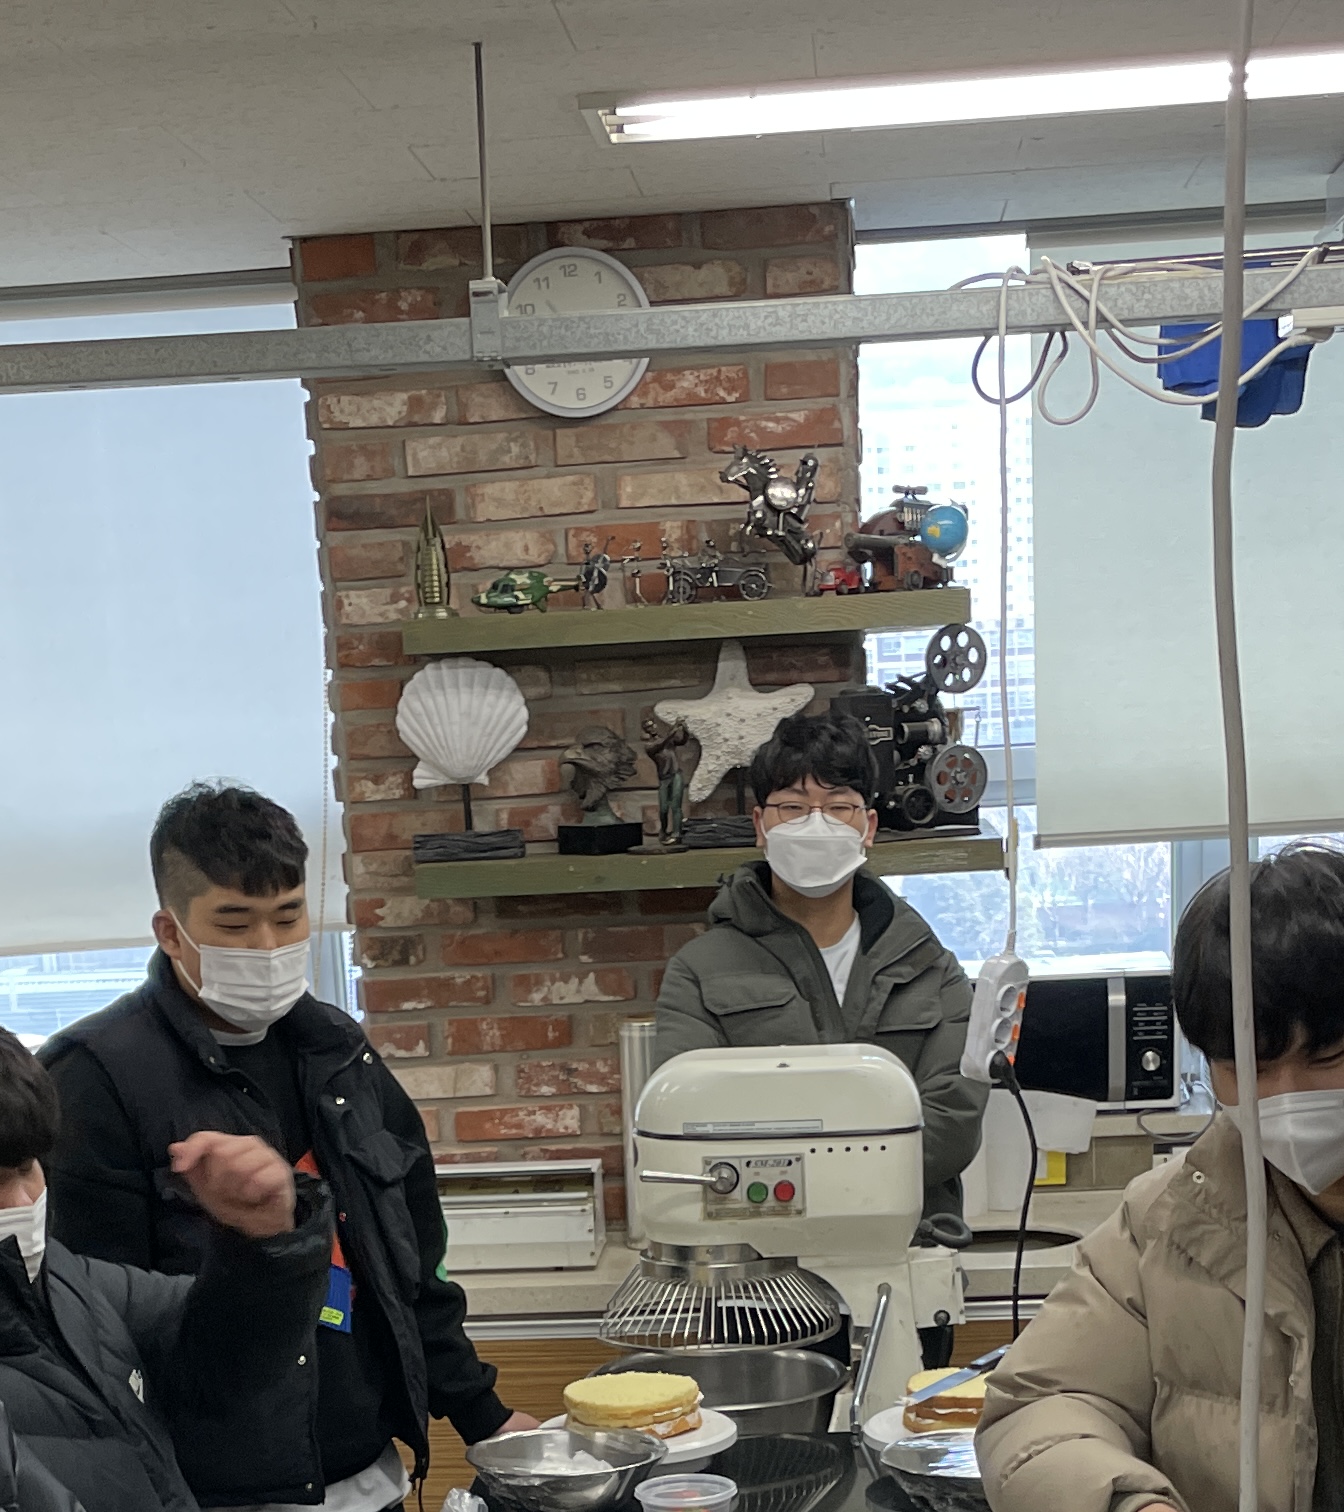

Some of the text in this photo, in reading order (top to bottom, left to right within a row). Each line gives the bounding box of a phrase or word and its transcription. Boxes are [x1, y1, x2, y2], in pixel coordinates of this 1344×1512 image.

[559, 263, 578, 278] 12
[594, 271, 602, 284] 1
[533, 276, 550, 290] 11
[617, 293, 627, 307] 2
[516, 303, 535, 315] 10
[547, 381, 558, 396] 7
[603, 375, 614, 389] 5
[576, 387, 587, 401] 6
